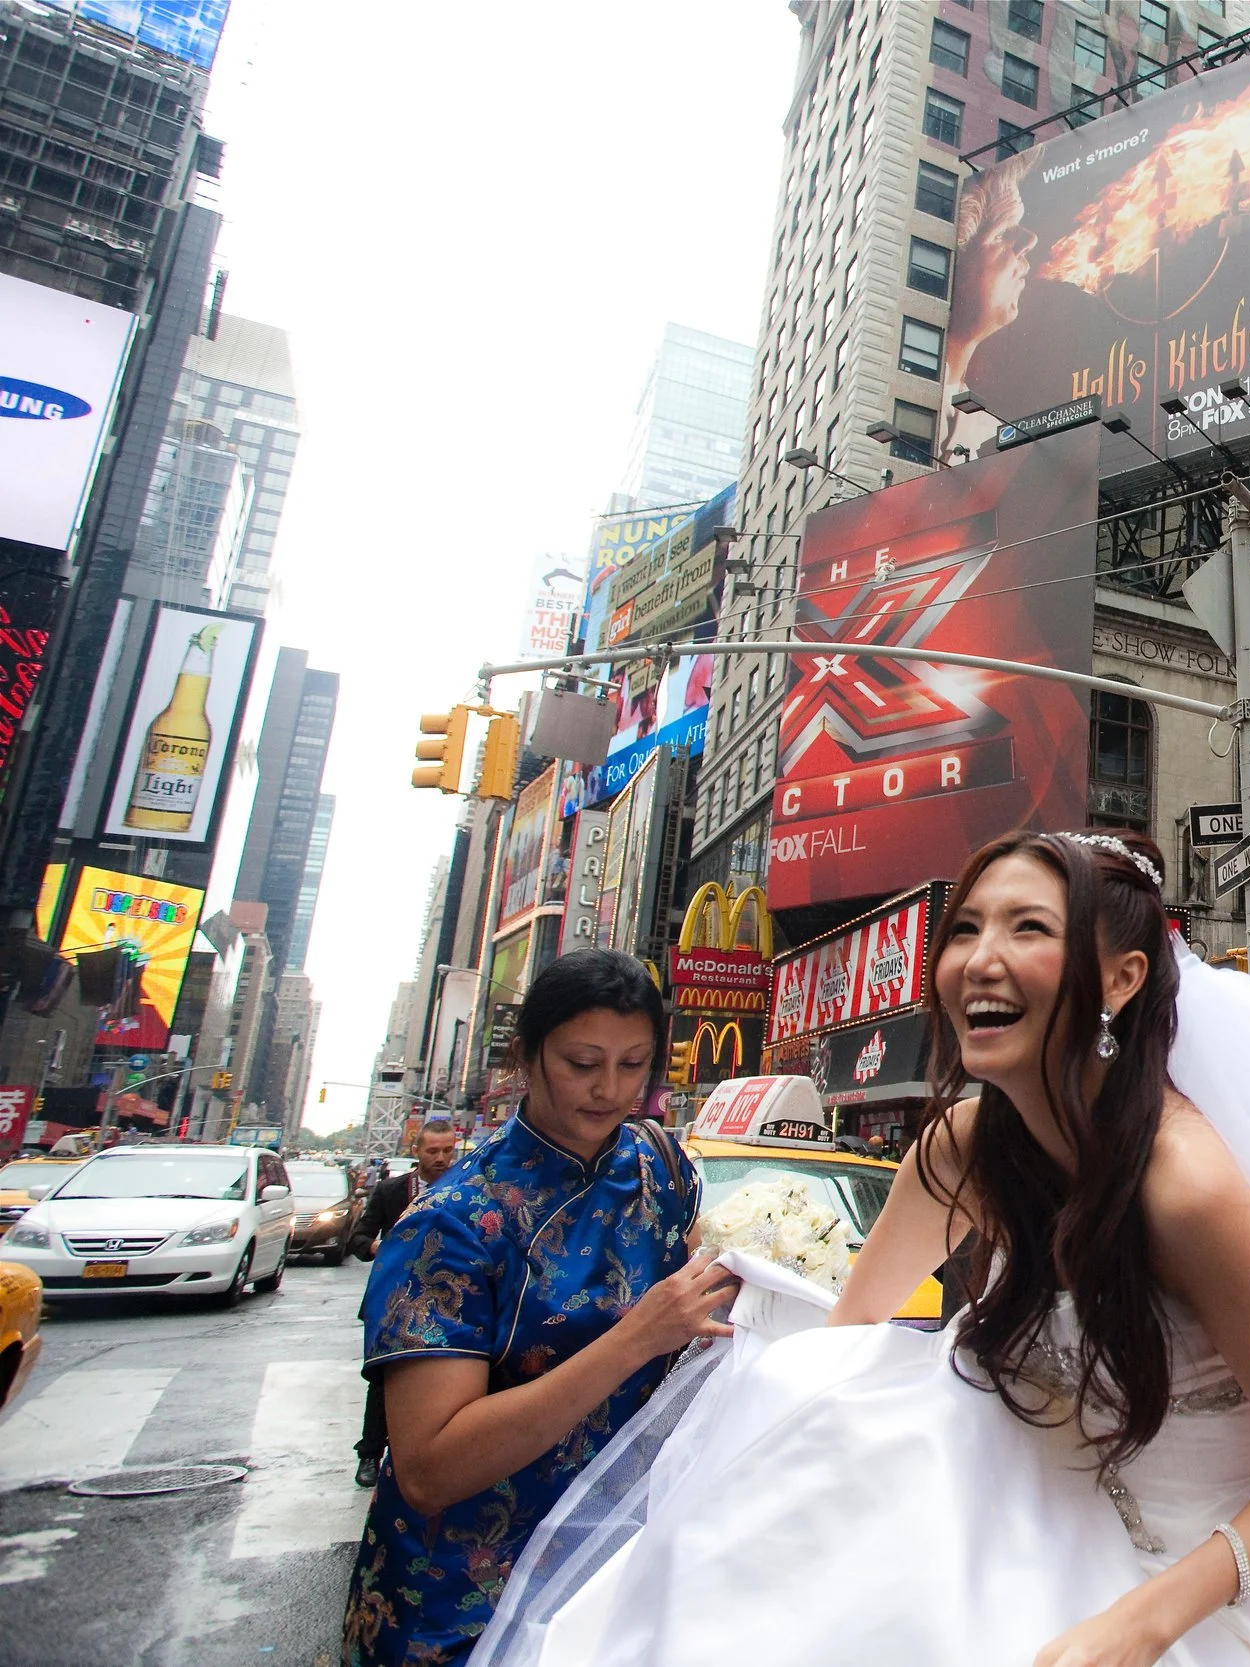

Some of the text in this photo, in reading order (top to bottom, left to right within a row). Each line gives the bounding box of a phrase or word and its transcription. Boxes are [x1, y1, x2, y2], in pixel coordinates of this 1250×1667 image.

[1042, 128, 1149, 184] Want s'more?
[1046, 409, 1092, 429] SPECTACOLOR
[1167, 420, 1200, 441] 8PM
[1203, 399, 1246, 430] FOX
[671, 536, 690, 560] see
[609, 606, 632, 642] girl
[634, 582, 674, 621] benefit
[680, 558, 712, 590] from
[530, 638, 564, 651] THIS
[1112, 632, 1177, 664] SHOW
[150, 739, 206, 758] Corona
[142, 772, 194, 796] Light
[606, 763, 626, 787] FOR
[1209, 816, 1243, 833] ONE
[768, 824, 866, 866] FOX FALL
[1222, 858, 1239, 882] ONE
[573, 826, 604, 951] PALA
[676, 958, 773, 977] McDonald's
[692, 972, 757, 985] Restaurant
[727, 1093, 760, 1123] NYC
[780, 1121, 815, 1139] 2H91
